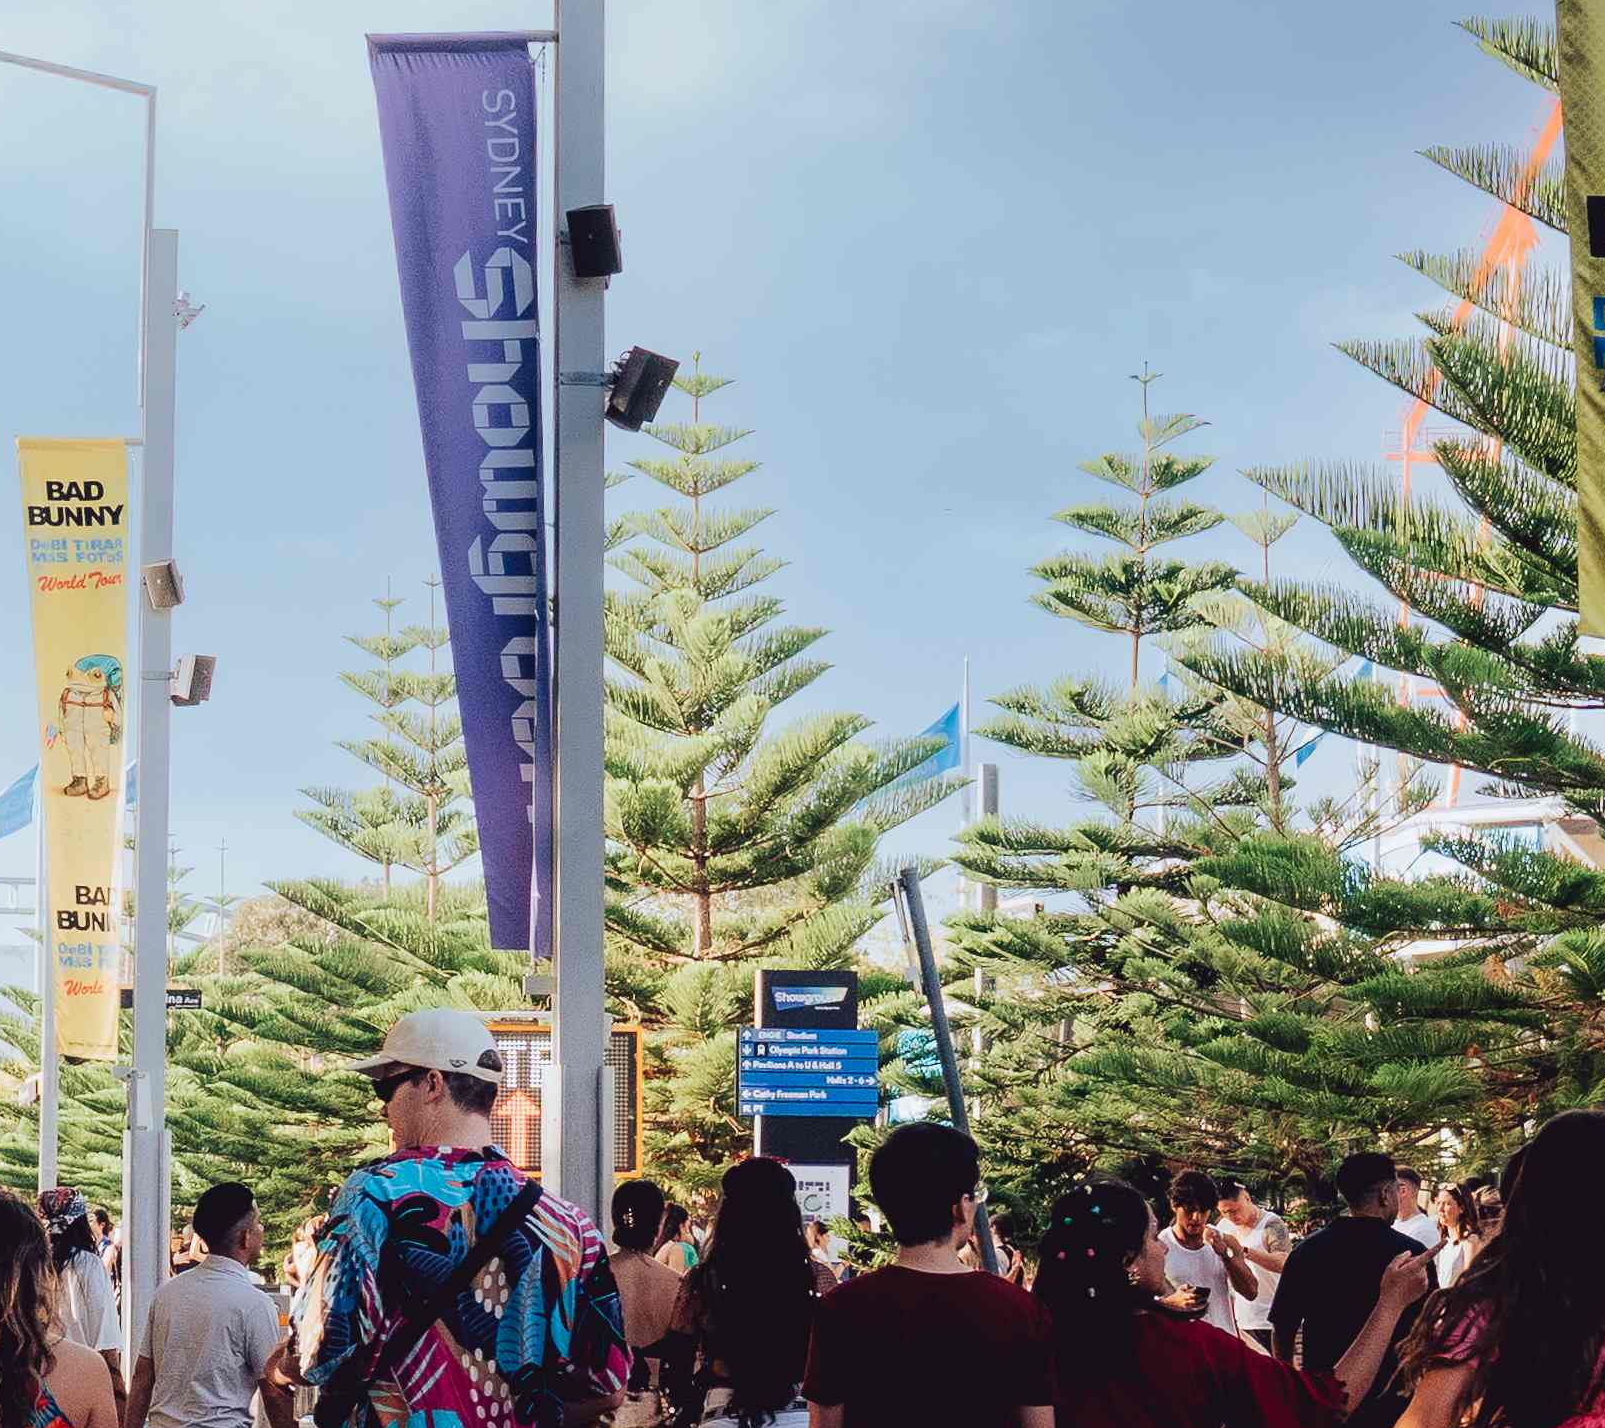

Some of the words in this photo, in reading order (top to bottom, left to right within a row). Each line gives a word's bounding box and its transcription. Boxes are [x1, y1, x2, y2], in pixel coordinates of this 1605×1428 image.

[482, 89, 528, 244] SYDNEY
[46, 480, 105, 501] BAD
[28, 504, 124, 526] BUNNY
[37, 574, 87, 592] World
[88, 571, 122, 589] Tour
[57, 910, 110, 932] BUN
[769, 1045, 800, 1057] Olympic
[801, 1045, 818, 1055] Park
[819, 1045, 848, 1055] Station
[787, 1061, 795, 1070] A
[795, 1061, 804, 1070] to
[819, 1061, 835, 1070] Hall
[826, 1076, 847, 1085] Halls
